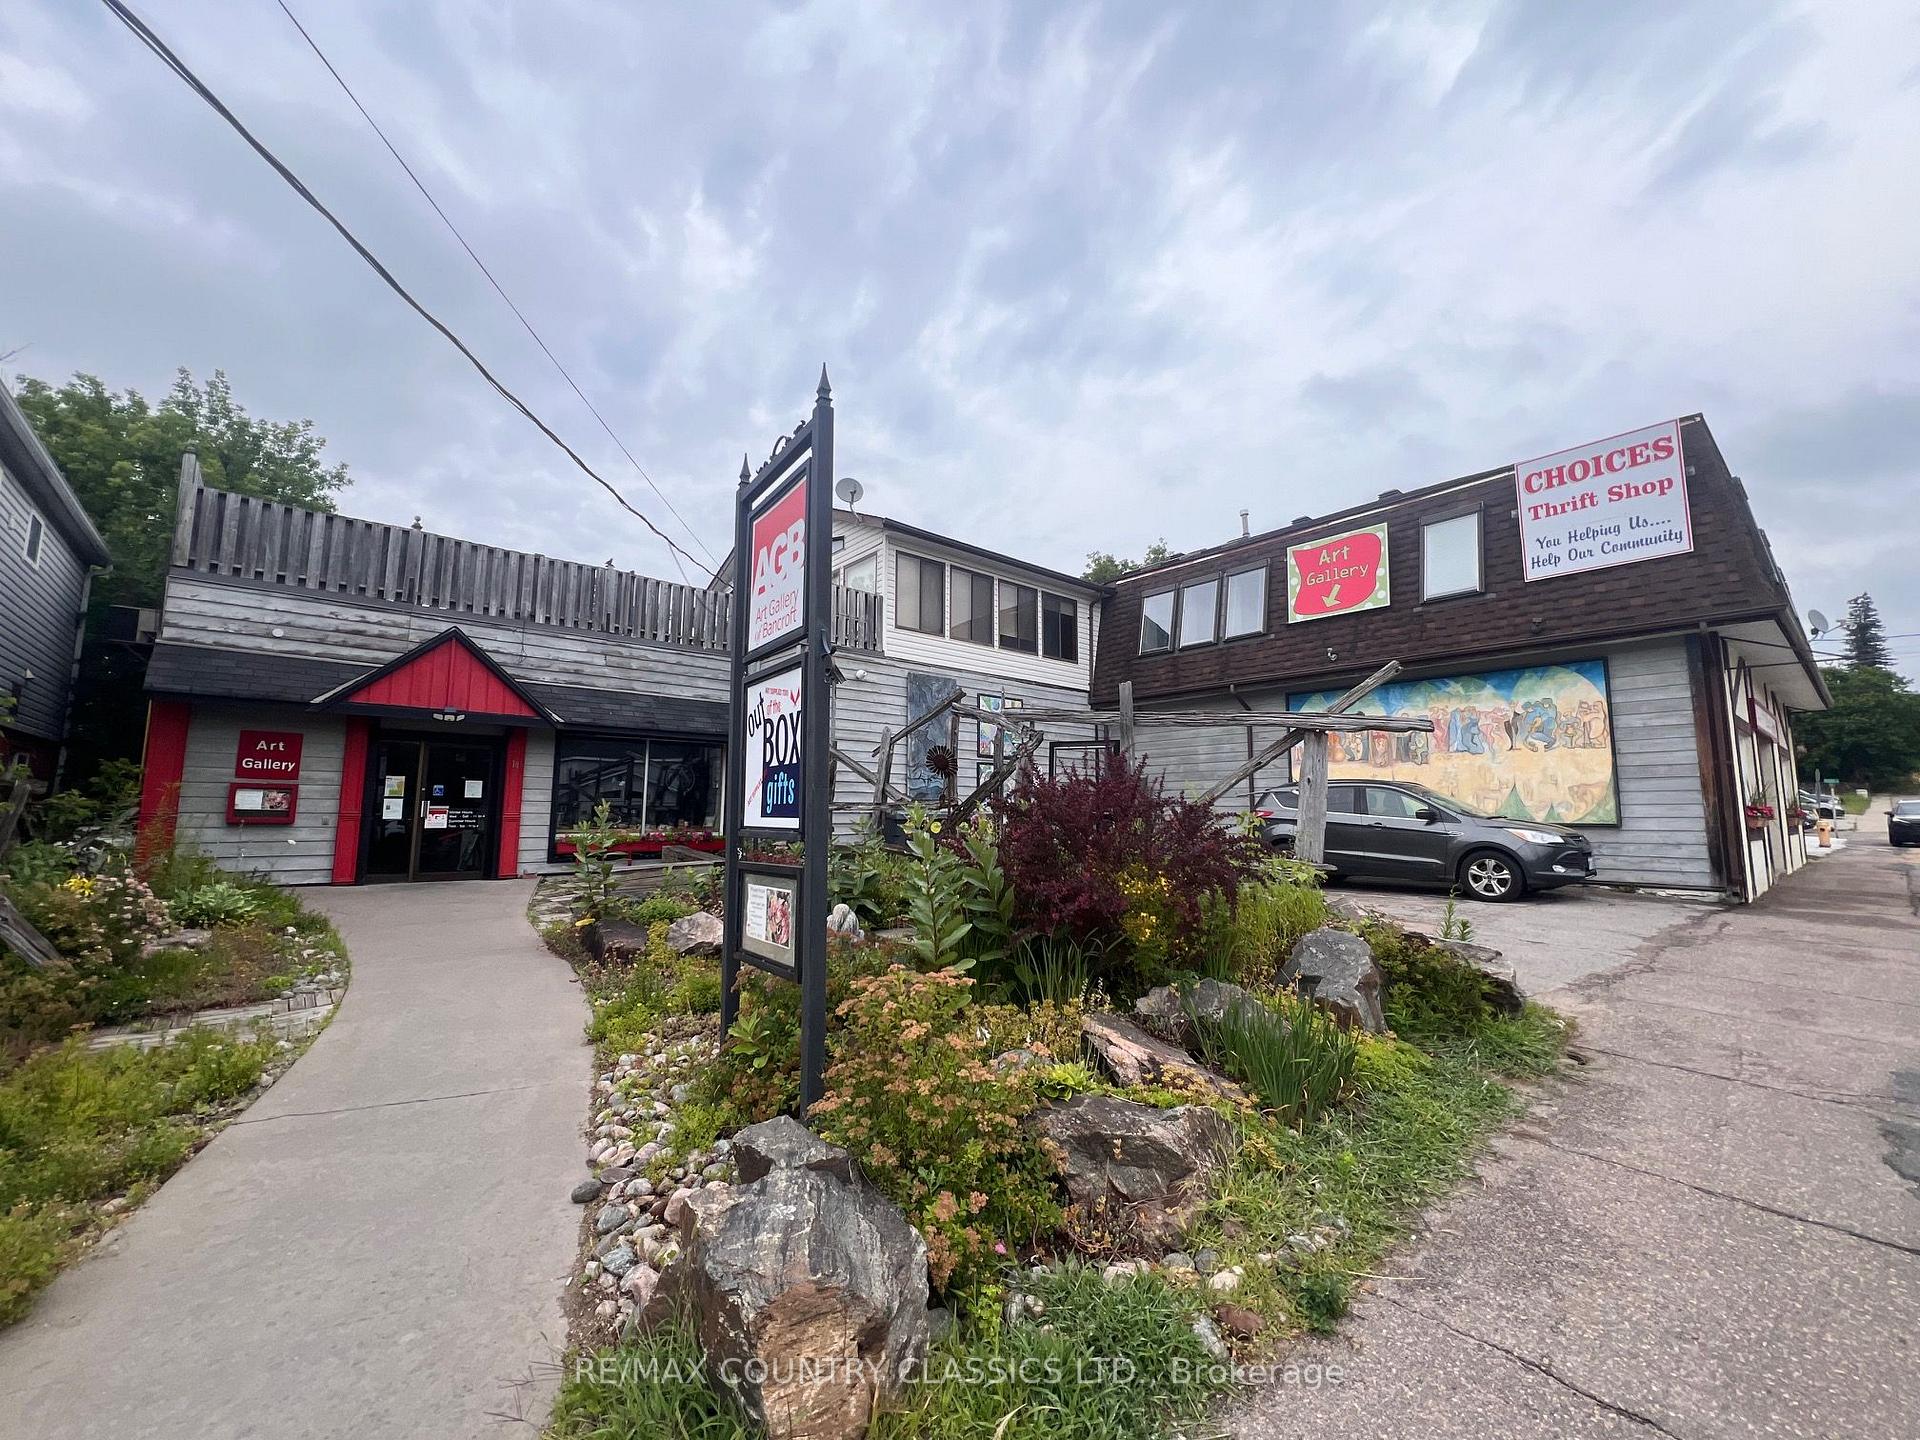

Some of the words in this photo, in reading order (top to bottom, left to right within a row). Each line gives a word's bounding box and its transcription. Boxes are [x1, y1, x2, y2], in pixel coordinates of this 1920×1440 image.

[1524, 435, 1675, 494] CHOICES
[1528, 491, 1599, 521] Thrift
[1607, 476, 1674, 503] Shop
[1319, 545, 1350, 566] Art
[1531, 552, 1561, 570] Help
[1568, 547, 1594, 561] Our
[1600, 527, 1683, 555] Community
[1536, 535, 1561, 550] You
[1568, 522, 1621, 544] Helping
[752, 518, 805, 602] AGB
[1306, 563, 1369, 586] Gallery
[755, 604, 767, 624] Art
[769, 588, 799, 617] Gallery
[762, 606, 797, 638] Bancroft
[748, 691, 765, 738] out
[256, 740, 285, 751] Art
[763, 710, 802, 765] BOX
[242, 757, 296, 772] Gallery
[766, 771, 795, 814] gifts
